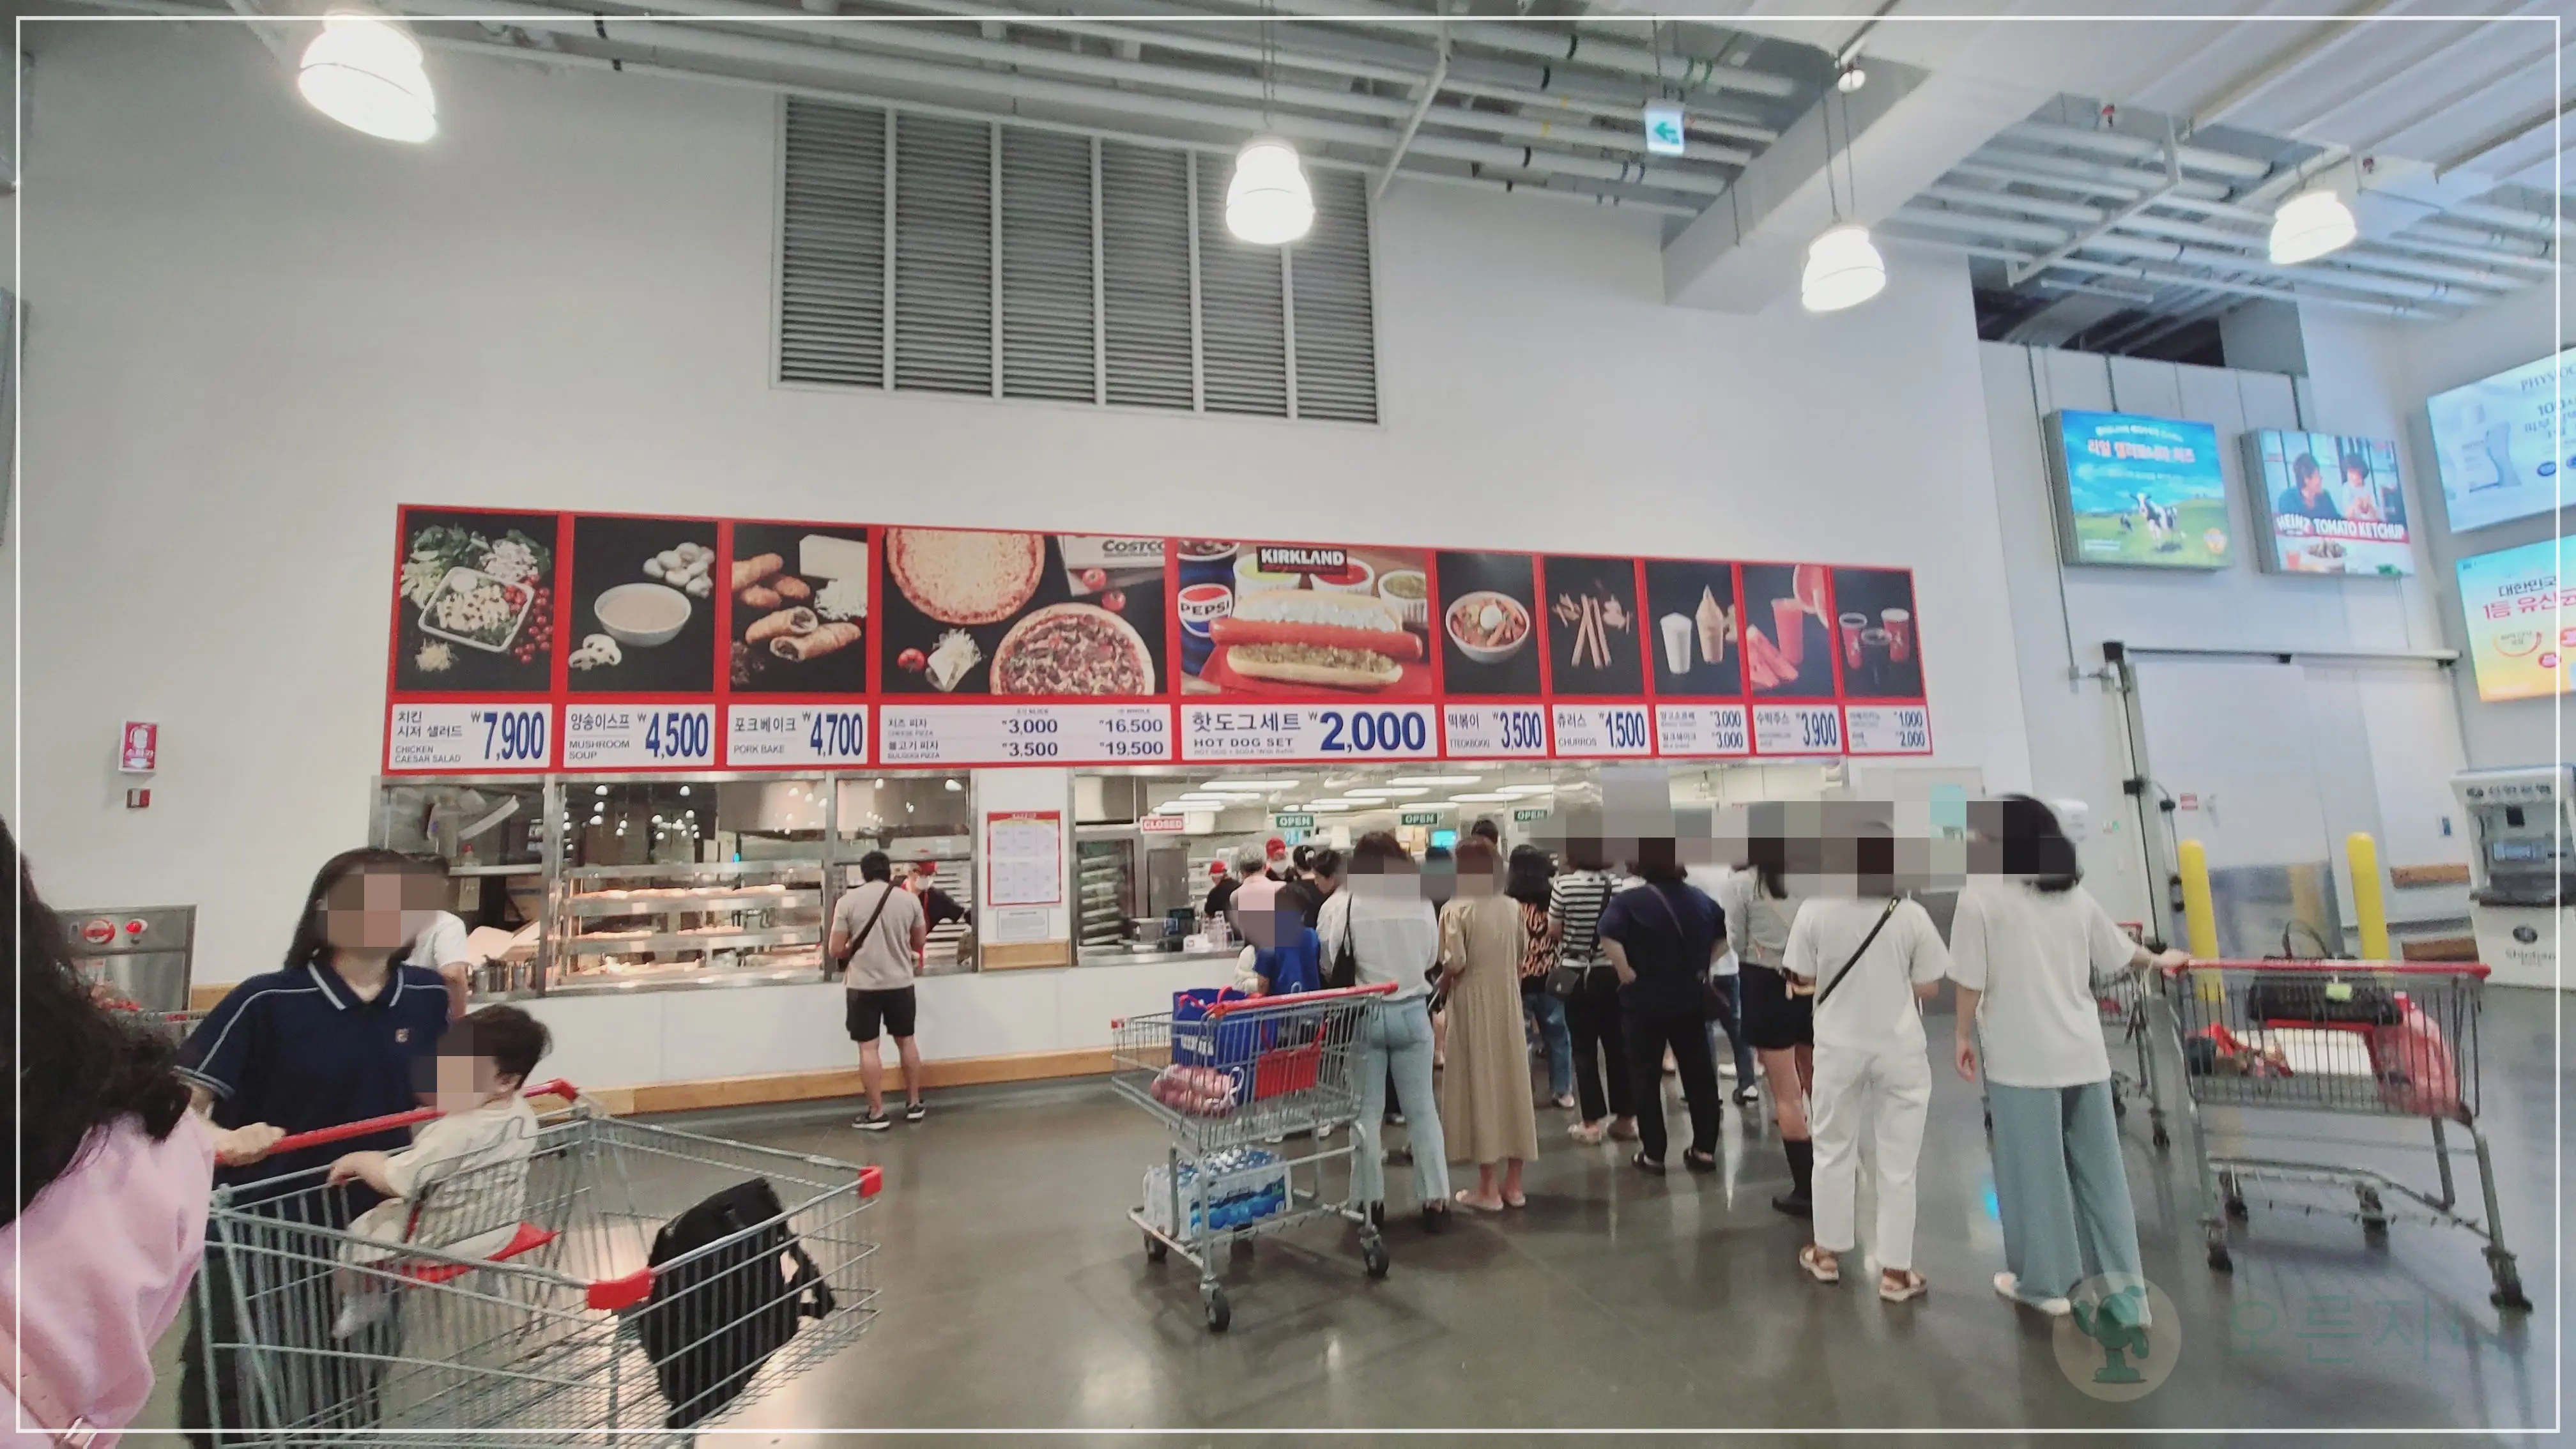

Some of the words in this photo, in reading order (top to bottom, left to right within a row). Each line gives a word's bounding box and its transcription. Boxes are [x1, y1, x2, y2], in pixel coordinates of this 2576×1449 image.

[2276, 514, 2311, 532] HEINZ
[2313, 518, 2357, 536] TOMATO
[2358, 521, 2405, 540] KETCHUP
[1261, 548, 1345, 567] KIRKLAND
[1181, 599, 1229, 615] PEPSI
[2483, 601, 2511, 620] 1등
[398, 710, 422, 723] 치킨
[571, 712, 629, 731] 양송이스프
[1193, 712, 1301, 733] 핫도그세트
[397, 724, 422, 738] 시저
[733, 717, 796, 733] 포크베이크
[569, 740, 630, 749] MUSHROOM
[1194, 738, 1224, 747] HOT
[1230, 738, 1261, 747] DOG
[1266, 737, 1293, 747] SET
[1558, 737, 1597, 747] CHURROS
[395, 746, 433, 755] CHICKEN
[733, 744, 759, 754] PORK
[760, 744, 785, 753] BAKE
[395, 754, 430, 763] CAESAR
[433, 753, 461, 763] SALAD
[1405, 813, 1436, 824] OPEN
[1517, 809, 1545, 820] OPEN
[1143, 819, 1183, 830] CLOSED
[1280, 815, 1311, 827] OPEN
